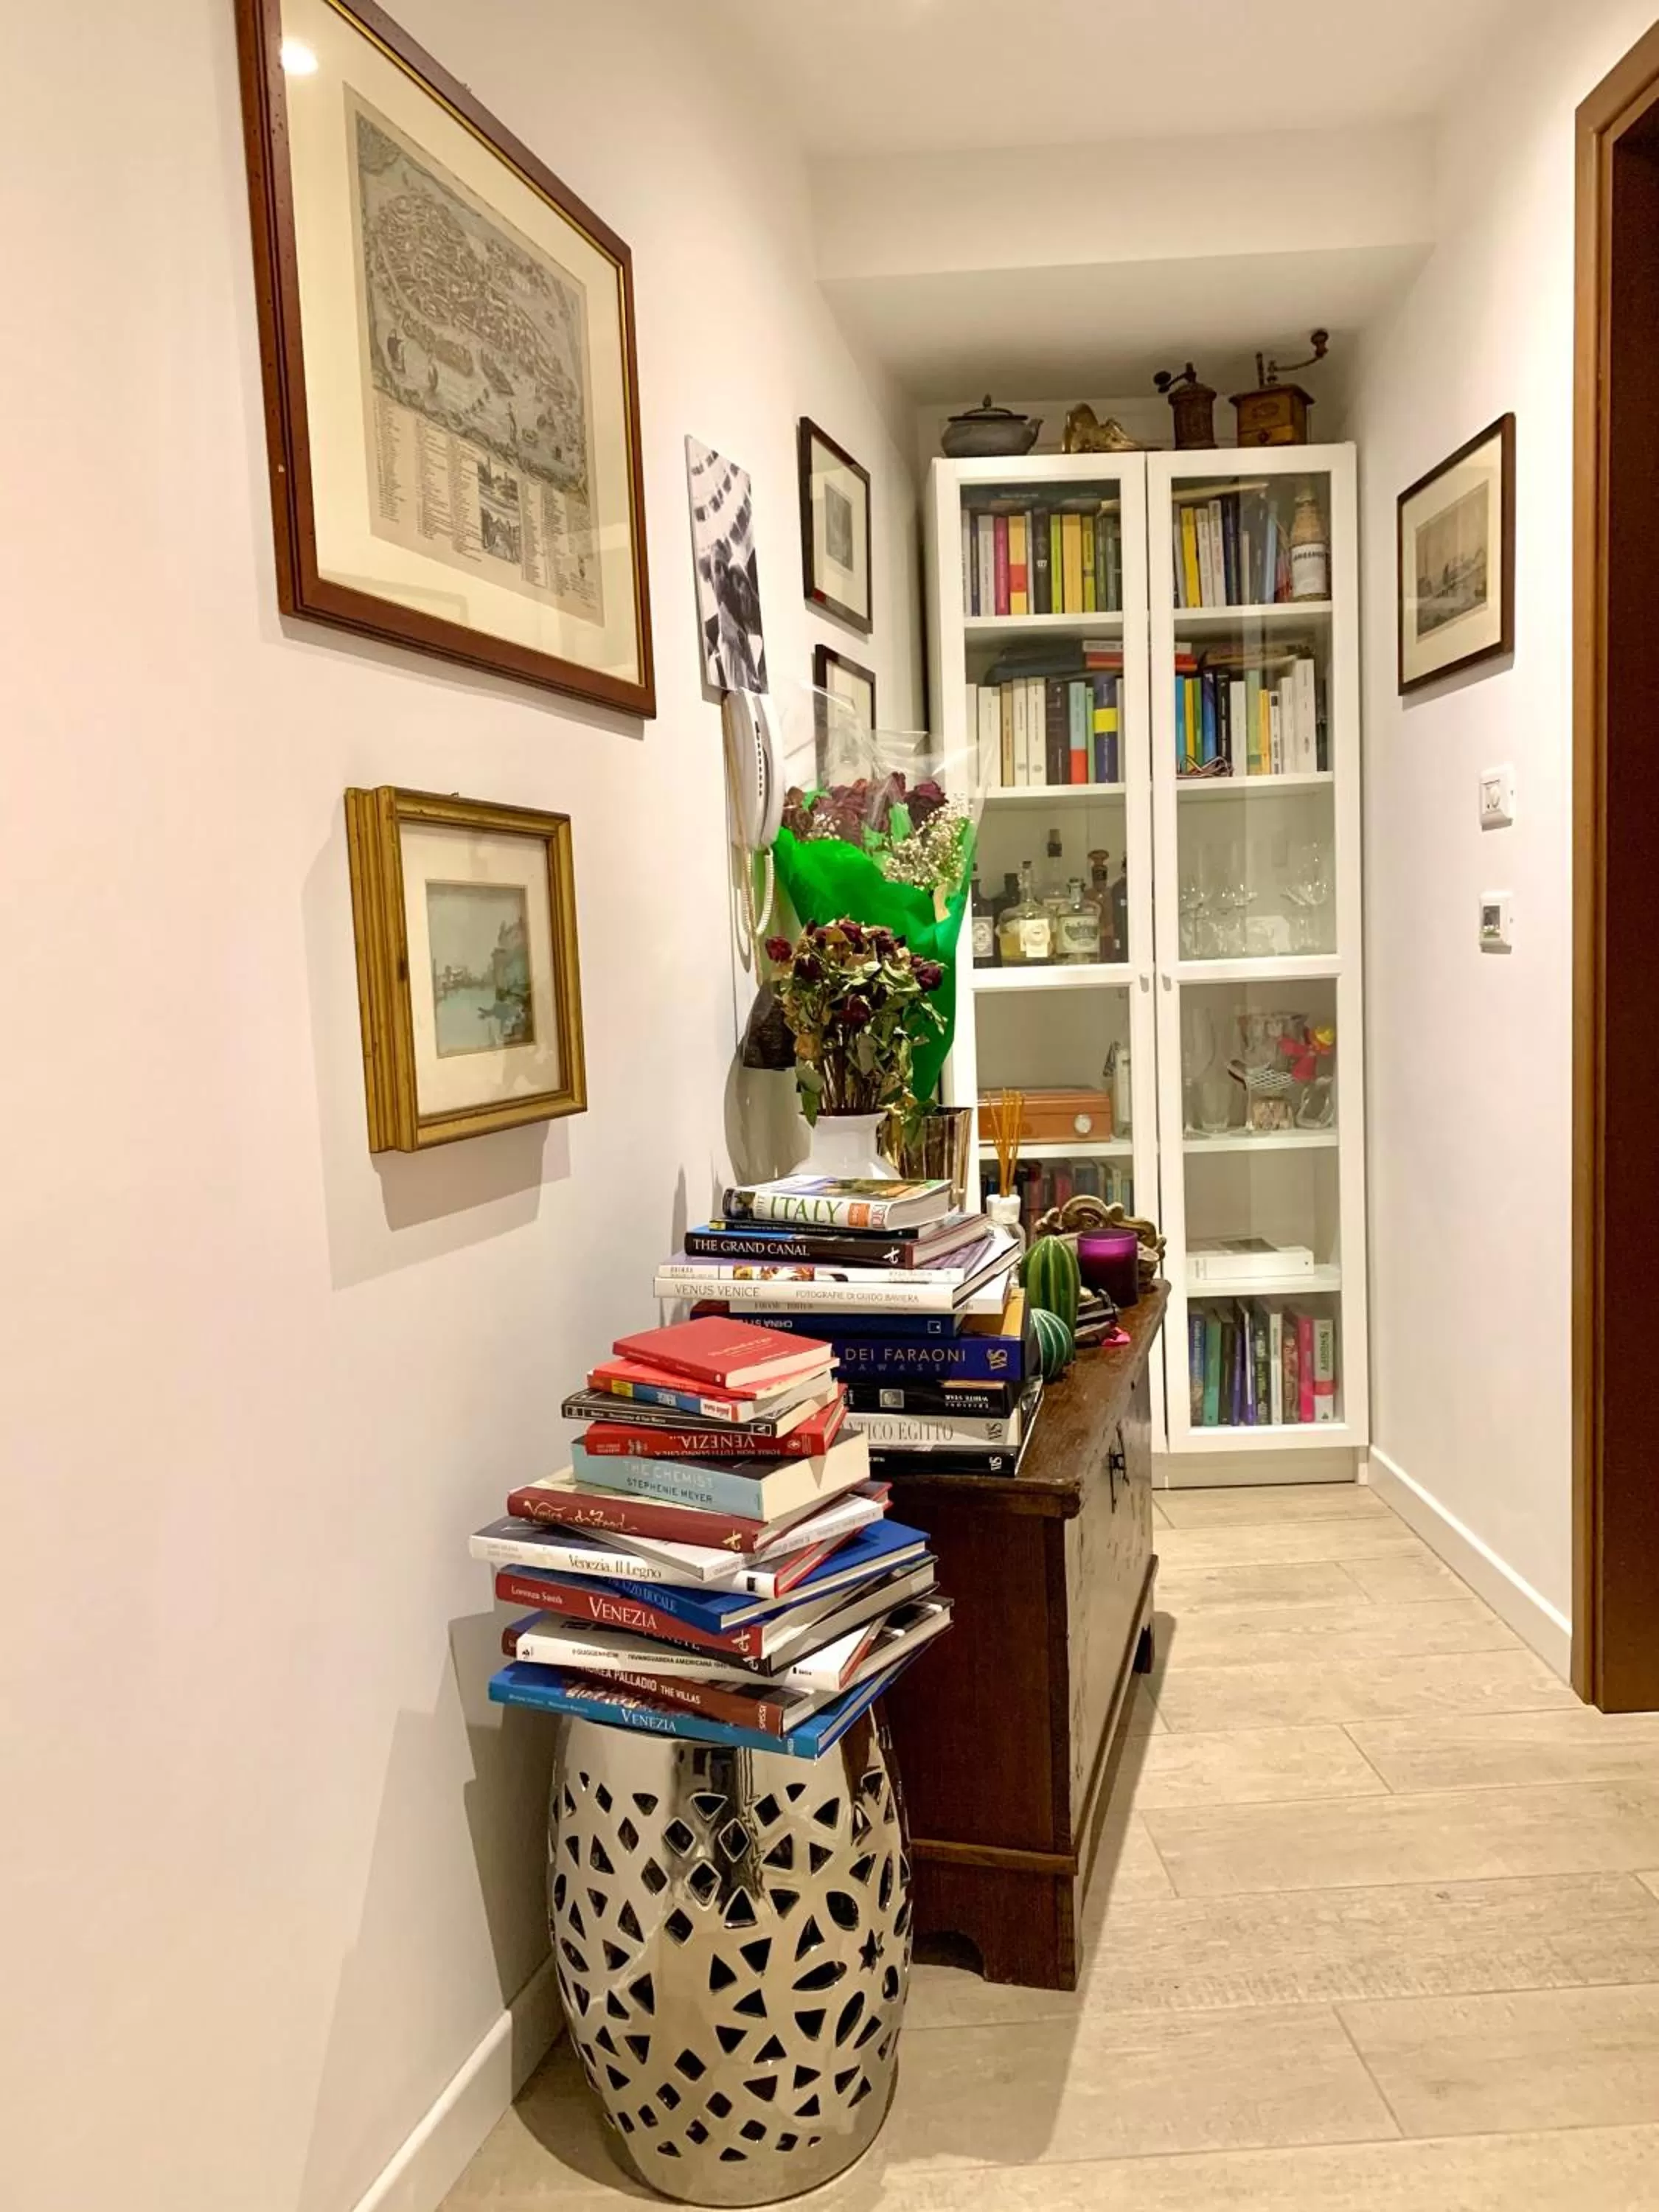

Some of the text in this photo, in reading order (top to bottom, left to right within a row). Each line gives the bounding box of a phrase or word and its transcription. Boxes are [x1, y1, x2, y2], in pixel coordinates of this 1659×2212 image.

[770, 1195, 844, 1225] ITALY
[692, 1238, 810, 1256] THE GRAND CANAL
[675, 1284, 714, 1296] VENUS
[717, 1285, 760, 1298] VENICE
[844, 1348, 966, 1363] DEI FARAONI
[842, 1421, 954, 1441] TICO EGITTO
[623, 1460, 714, 1489] THE CHEMIST
[626, 1478, 713, 1503] STEPHENIE MEYER
[627, 1559, 662, 1579] Legno
[588, 1596, 658, 1630] VENEZIA
[613, 1669, 658, 1693] PALLADIO
[660, 1686, 677, 1699] THE
[676, 1689, 701, 1705] VILLAS
[620, 1708, 677, 1733] VENEZIA
